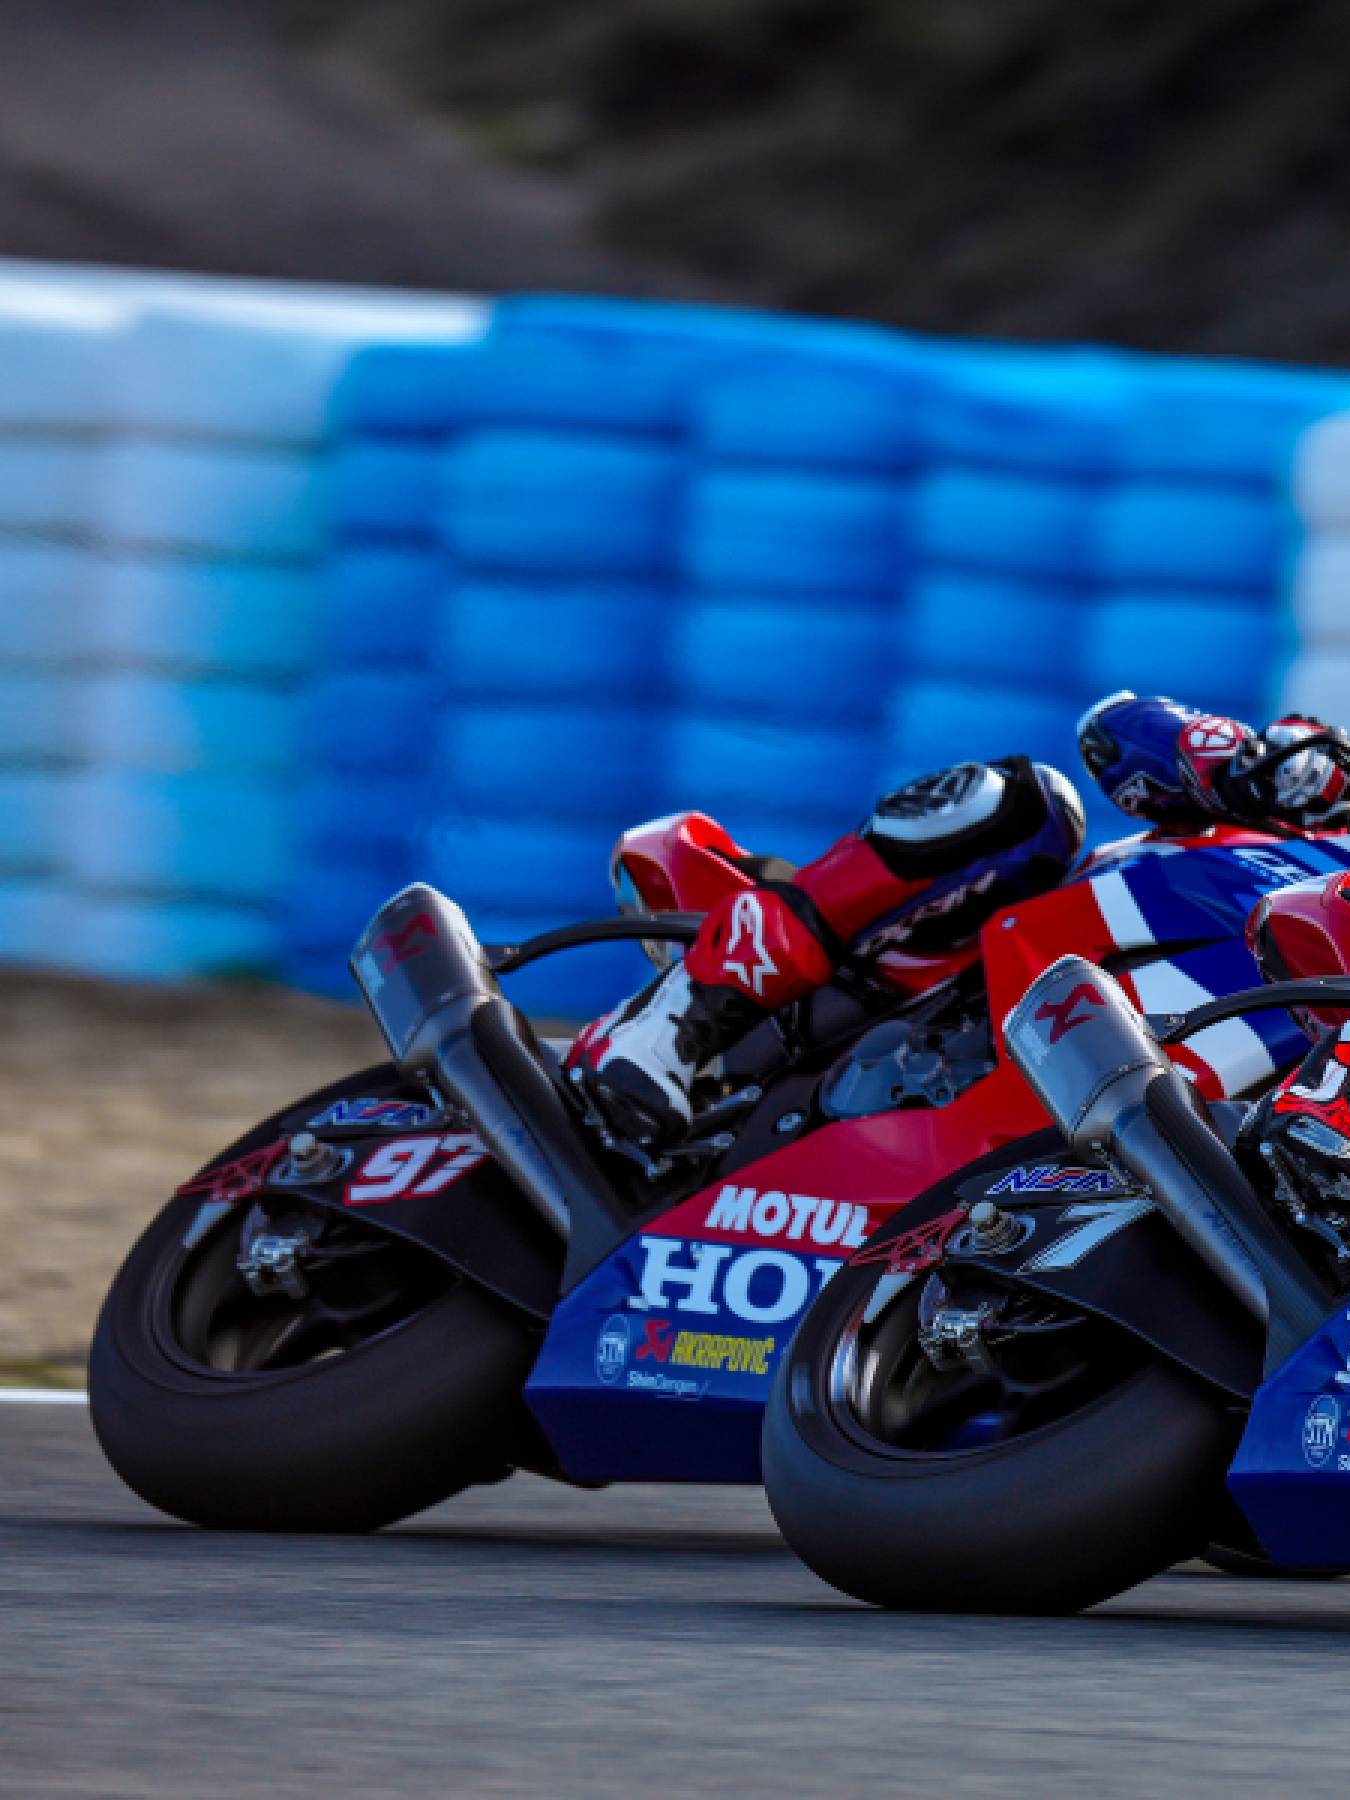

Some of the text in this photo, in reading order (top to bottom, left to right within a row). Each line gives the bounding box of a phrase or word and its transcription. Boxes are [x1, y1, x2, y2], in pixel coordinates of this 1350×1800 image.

[345, 1131, 491, 1206] 97
[704, 1184, 870, 1249] MOTUL
[1022, 1198, 1155, 1272] 7
[627, 1235, 845, 1324] HO
